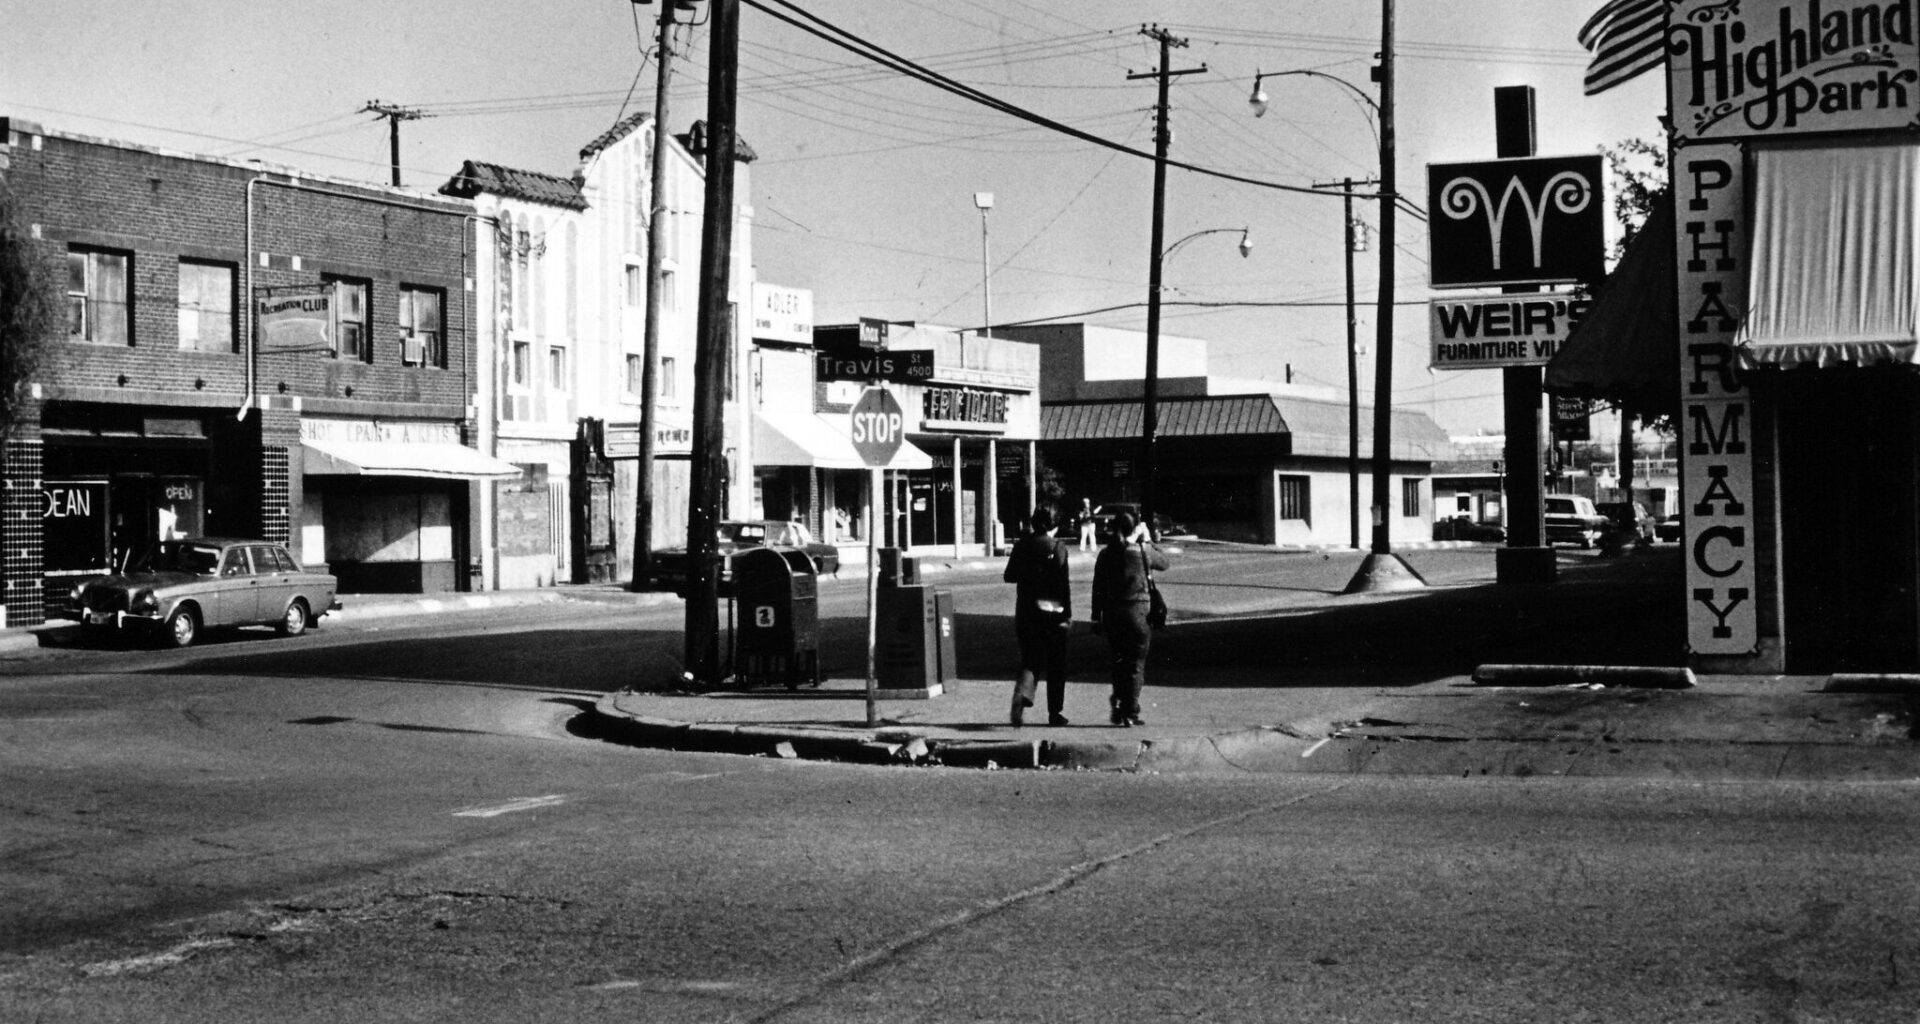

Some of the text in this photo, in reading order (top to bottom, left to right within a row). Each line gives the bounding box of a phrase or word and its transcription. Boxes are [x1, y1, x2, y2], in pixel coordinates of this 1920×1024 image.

[1668, 0, 1915, 130] Highland
[302, 298, 329, 312] CLUB
[1437, 339, 1563, 361] FURNITURE VIL
[820, 355, 895, 375] Travis
[906, 365, 932, 377] 4500
[1686, 158, 1749, 639] PHARMACY
[853, 412, 901, 443] STOP
[165, 484, 193, 501] OPEN
